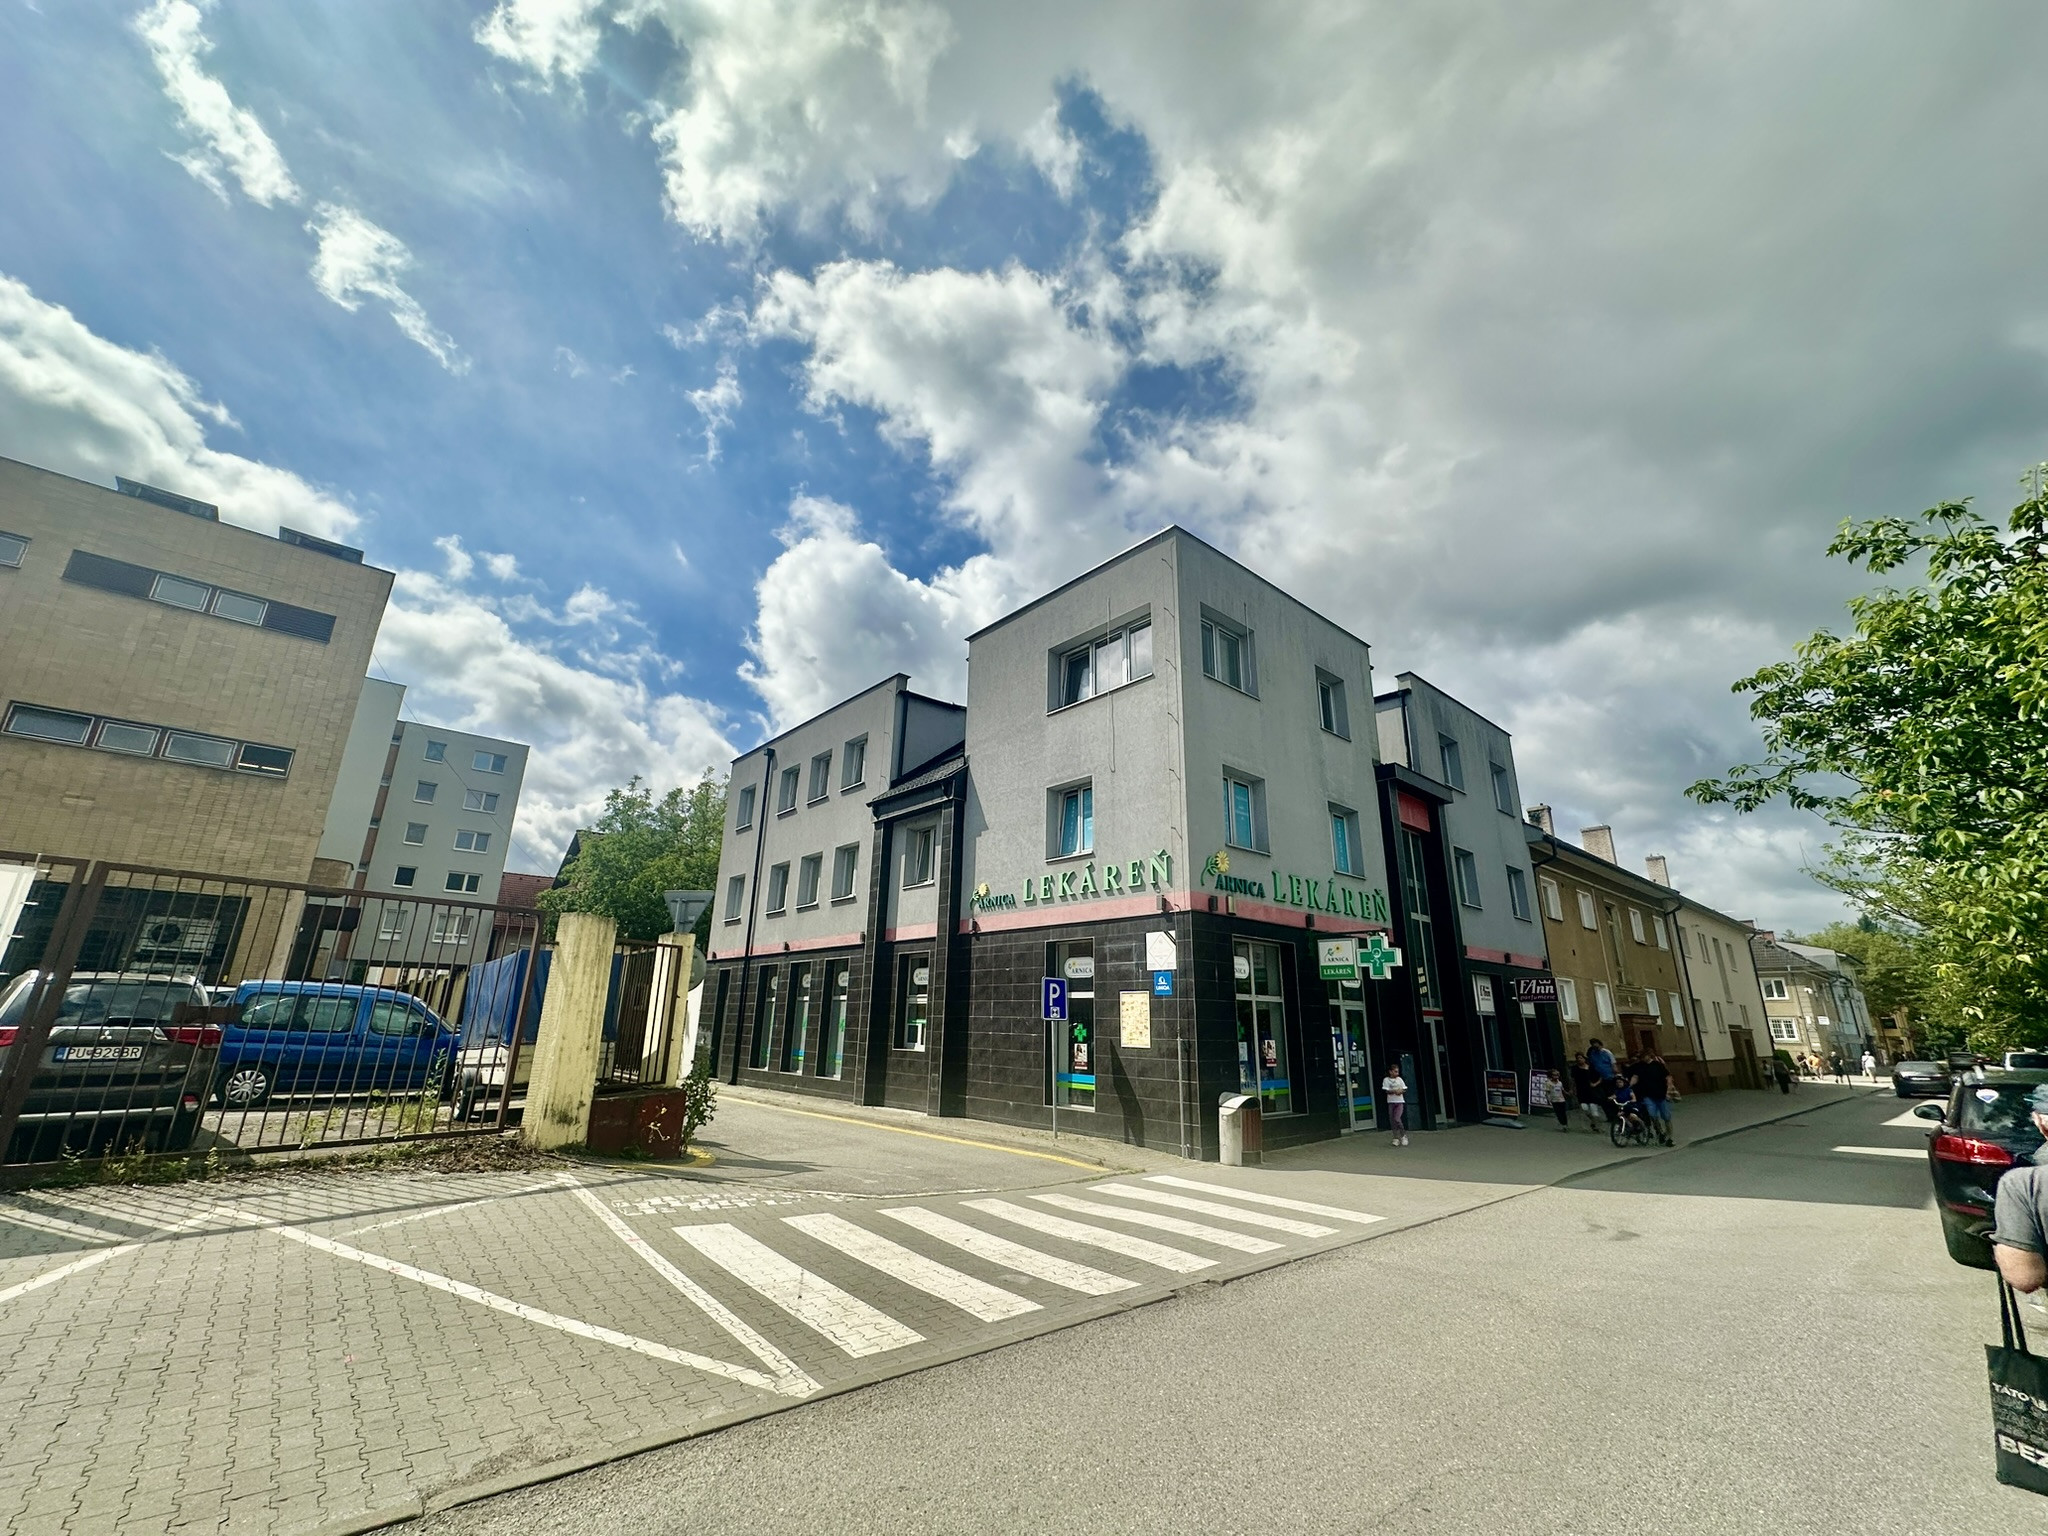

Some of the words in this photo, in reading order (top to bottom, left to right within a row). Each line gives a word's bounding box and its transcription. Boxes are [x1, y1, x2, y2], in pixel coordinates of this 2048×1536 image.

[978, 893, 1017, 909] ARNICA
[1022, 849, 1172, 902] LEKÁREŇ
[1215, 873, 1266, 899] ARNICA
[1272, 870, 1388, 922] LEKÁREŇ
[1323, 967, 1352, 975] LEKÁREŇ
[1050, 983, 1061, 1006] P
[1520, 980, 1555, 994] FAnn
[1992, 1382, 2030, 1402] TÁTO
